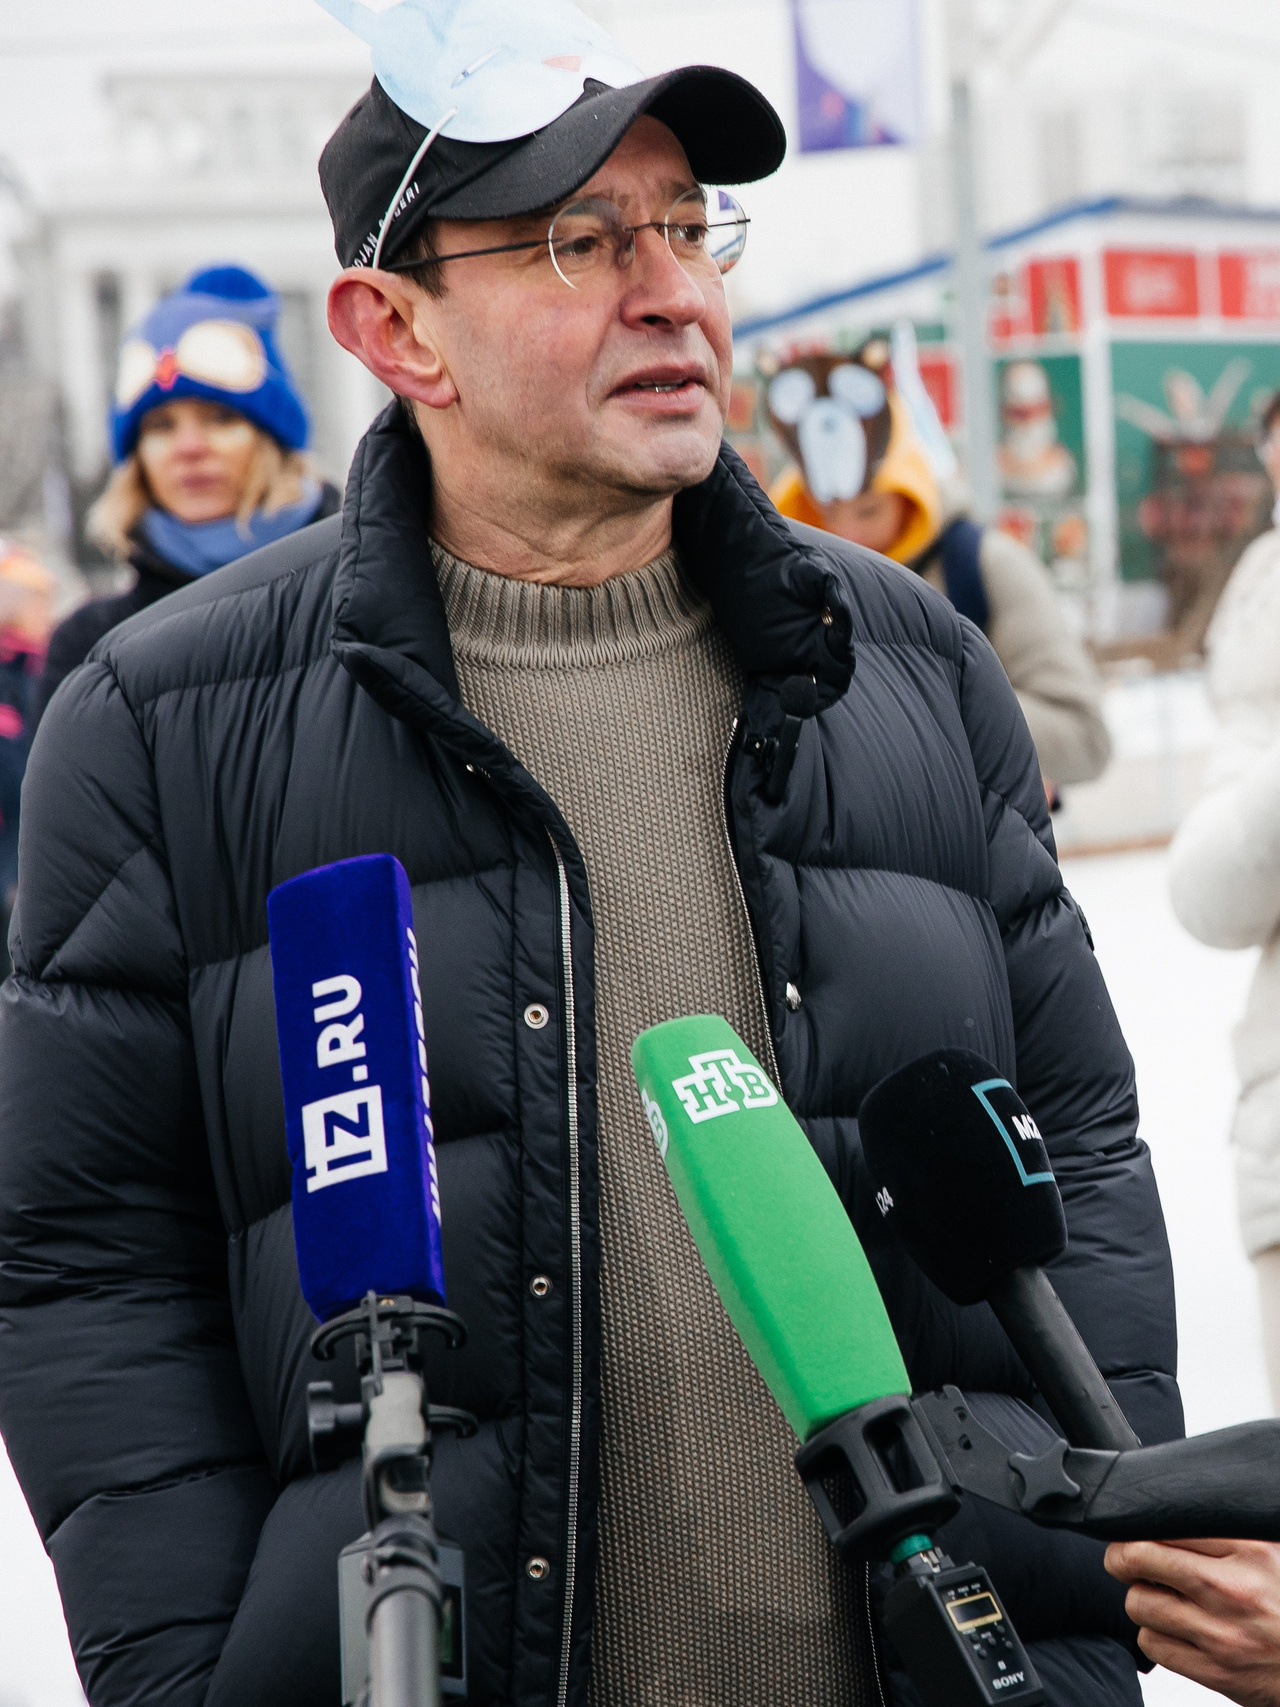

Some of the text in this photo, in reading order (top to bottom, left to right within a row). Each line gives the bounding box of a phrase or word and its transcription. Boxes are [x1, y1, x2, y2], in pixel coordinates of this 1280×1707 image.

[302, 973, 388, 1194] IZ.RU
[671, 1048, 779, 1125] НТВ
[991, 1671, 1025, 1691] SONY
